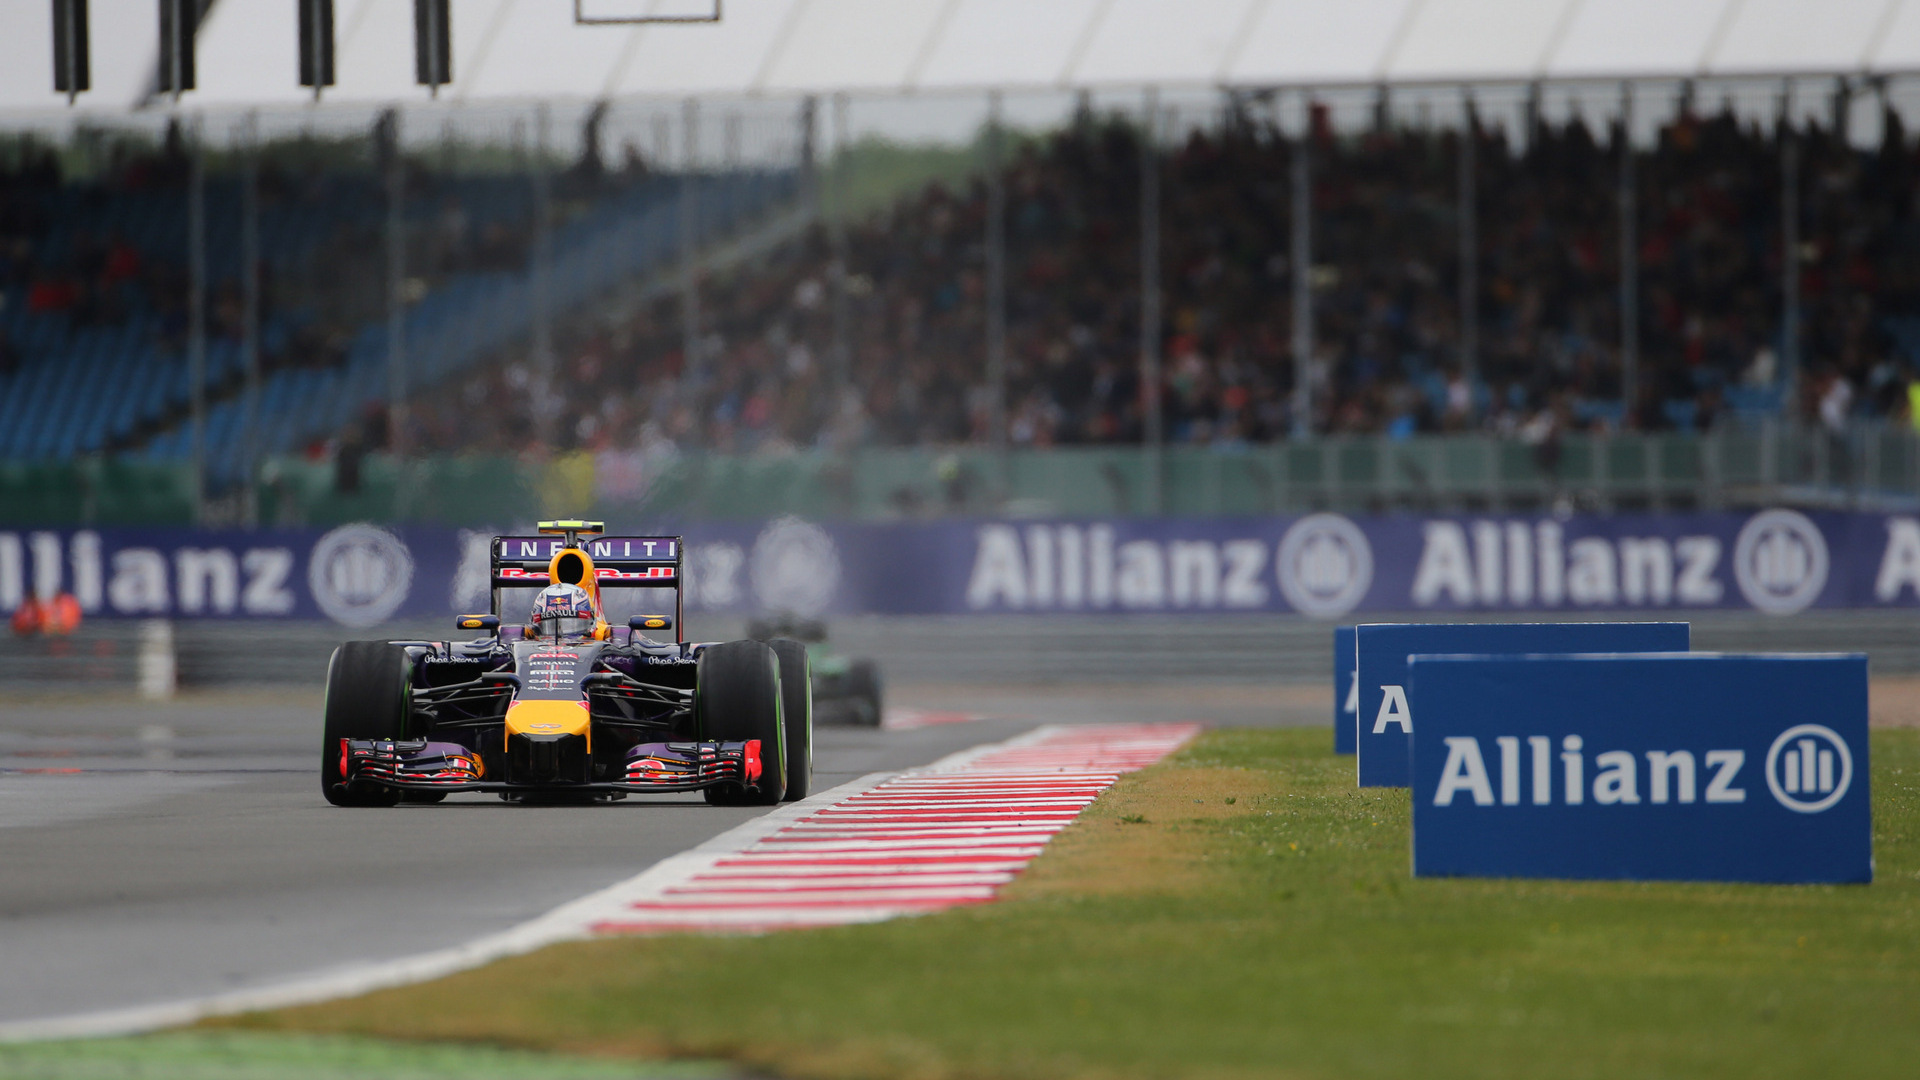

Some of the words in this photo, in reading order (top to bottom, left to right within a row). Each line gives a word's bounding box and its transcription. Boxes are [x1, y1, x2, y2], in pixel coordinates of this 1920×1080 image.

[501, 541, 675, 556] INFNITI
[966, 523, 1267, 608] Allianz
[1412, 519, 1724, 605] Allianz
[541, 609, 577, 619] RENAULT
[1433, 734, 1746, 806] Allianz
